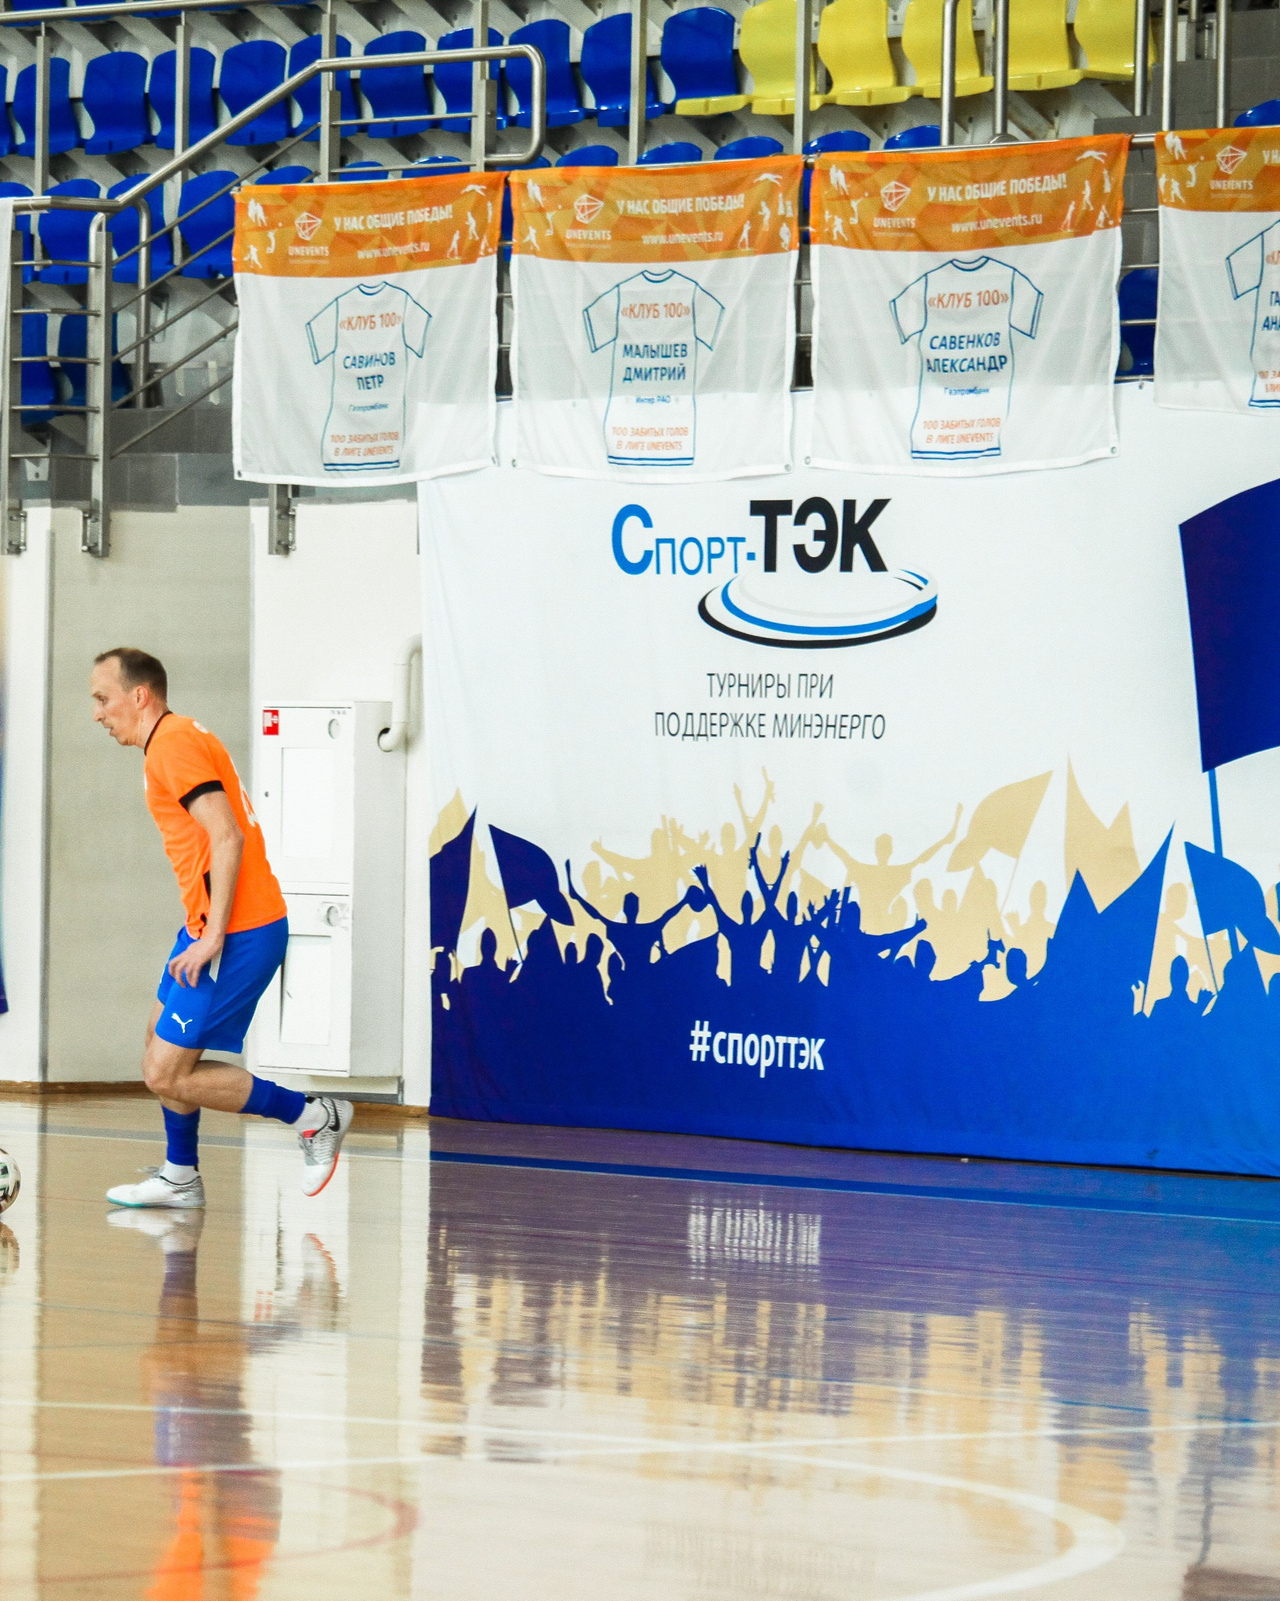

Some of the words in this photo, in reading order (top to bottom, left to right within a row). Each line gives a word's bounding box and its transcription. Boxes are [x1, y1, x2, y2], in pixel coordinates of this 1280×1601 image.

[927, 187, 936, 202] У
[938, 185, 963, 201] НАС
[965, 180, 1006, 201] ОБЩИЕ
[1009, 172, 1067, 194] ПОБЕДЫ!
[616, 201, 626, 215] У
[626, 199, 650, 214] НАС
[652, 198, 693, 217] ОБЩИЕ
[695, 193, 745, 212] ПОБЕДЫ!
[334, 216, 342, 230] У
[344, 216, 365, 230] НАС
[366, 211, 405, 229] ОБЩИЕ
[407, 204, 453, 225] ПОБЕДЫ!
[873, 217, 916, 228] UNEVENTS
[951, 213, 1043, 233] www.unevents.ru
[566, 229, 612, 241] UNEVENTS
[641, 231, 724, 245] www.unevents.ru
[288, 246, 329, 257] UNEVENTS
[357, 242, 430, 259] www.unevents.ru
[928, 292, 972, 309] «КЛУБ
[977, 289, 1009, 307] 100»
[621, 303, 660, 318] «КЛУБ
[663, 302, 690, 318] 100»
[339, 314, 376, 330] «КЛУБ
[379, 312, 402, 328] 100»
[929, 332, 1000, 350] САВЕНКОВ
[622, 343, 688, 359] МАЛЫШЕВ
[343, 352, 396, 369] САВИНОВ
[926, 355, 1008, 373] АЛЕКСАНДР
[357, 374, 384, 390] ПЕТР
[622, 363, 686, 383] ДМИТРИЙ
[707, 673, 791, 699] ТУРНИРЫ
[797, 673, 834, 699] ПРИ
[654, 711, 766, 742] ПОДДЕРЖКЕ
[772, 713, 886, 740] МИНЭНЕРГО
[689, 1020, 826, 1078] #спорттэк
